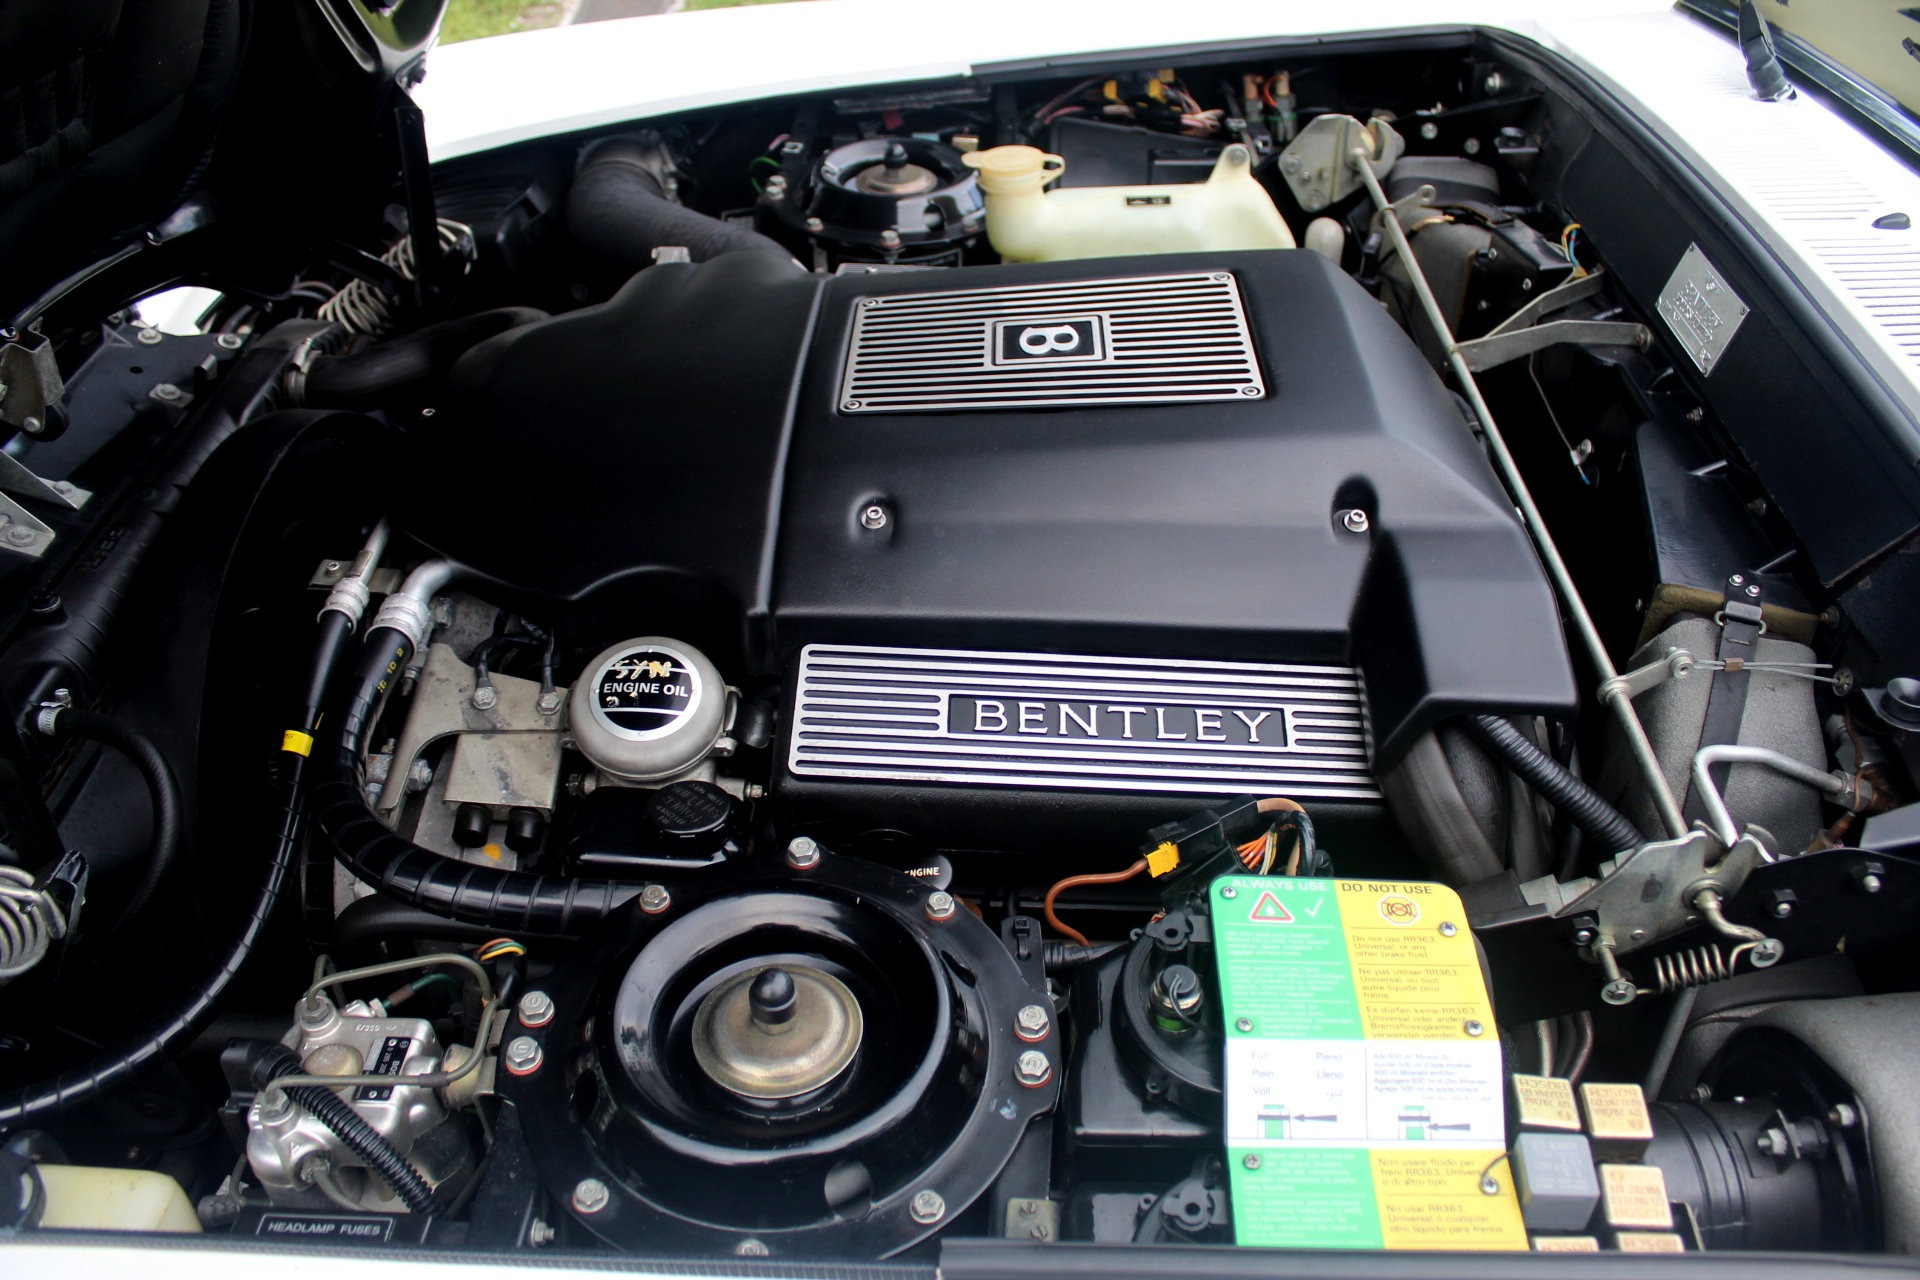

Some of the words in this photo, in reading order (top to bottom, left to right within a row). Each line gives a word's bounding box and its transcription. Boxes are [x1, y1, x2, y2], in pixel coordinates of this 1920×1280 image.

[603, 682, 660, 694] ENGINE
[663, 684, 689, 698] OIL
[973, 700, 1271, 743] BENTLEY
[904, 867, 940, 877] NGINE
[1232, 879, 1293, 891] ALWAYS
[1298, 881, 1327, 891] USE
[1341, 883, 1363, 892] DO
[1369, 884, 1399, 894] NOT
[1403, 885, 1433, 895] USE
[1356, 950, 1378, 958] other
[1388, 984, 1417, 992] liquide
[1367, 1006, 1378, 1014] Es
[1368, 1014, 1410, 1022] Universal
[1373, 1031, 1419, 1039] verwendet
[1252, 1051, 1269, 1060] Full
[1316, 1052, 1343, 1061] Pieno
[388, 1060, 400, 1076] BOS
[1252, 1069, 1274, 1078] Plein
[1317, 1070, 1343, 1079] Lleno
[1520, 1078, 1567, 1090] BOSCH
[1253, 1087, 1271, 1095] Voll
[1378, 1158, 1400, 1166] Non
[1431, 1158, 1457, 1166] fluido
[1381, 1168, 1402, 1176] freni
[1388, 1215, 1433, 1223] Universal
[1445, 1215, 1489, 1224] cualquier
[268, 1222, 335, 1234] HEADLAMP
[340, 1224, 381, 1236] FUSES
[1449, 1226, 1470, 1234] para
